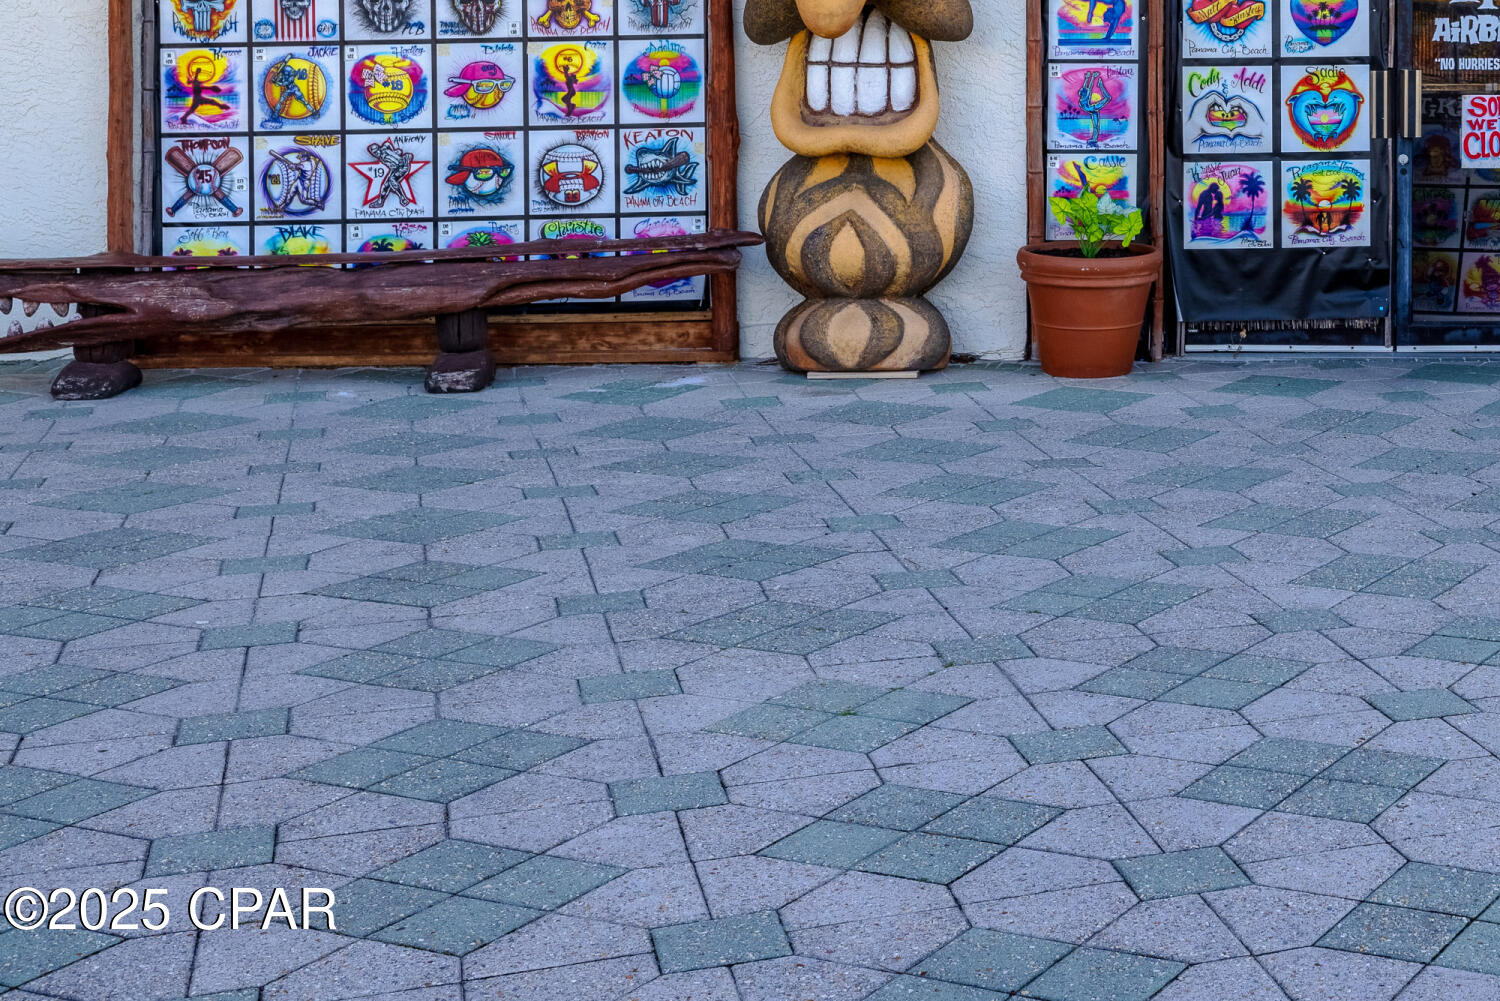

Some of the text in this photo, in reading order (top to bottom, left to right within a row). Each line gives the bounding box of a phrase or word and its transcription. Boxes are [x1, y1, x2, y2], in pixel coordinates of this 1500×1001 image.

[1185, 38, 1267, 57] Panama City Beach
[1188, 67, 1266, 98] Cody Addi
[1305, 65, 1345, 86] Sadie
[294, 136, 340, 148] SHANE
[623, 129, 694, 150] KEATON
[1218, 166, 1240, 186] Juan
[564, 190, 580, 202] 33
[624, 196, 650, 208] PANAMA
[666, 192, 698, 207] BEACH
[274, 225, 325, 243] BLAKE
[540, 219, 605, 239] Christie
